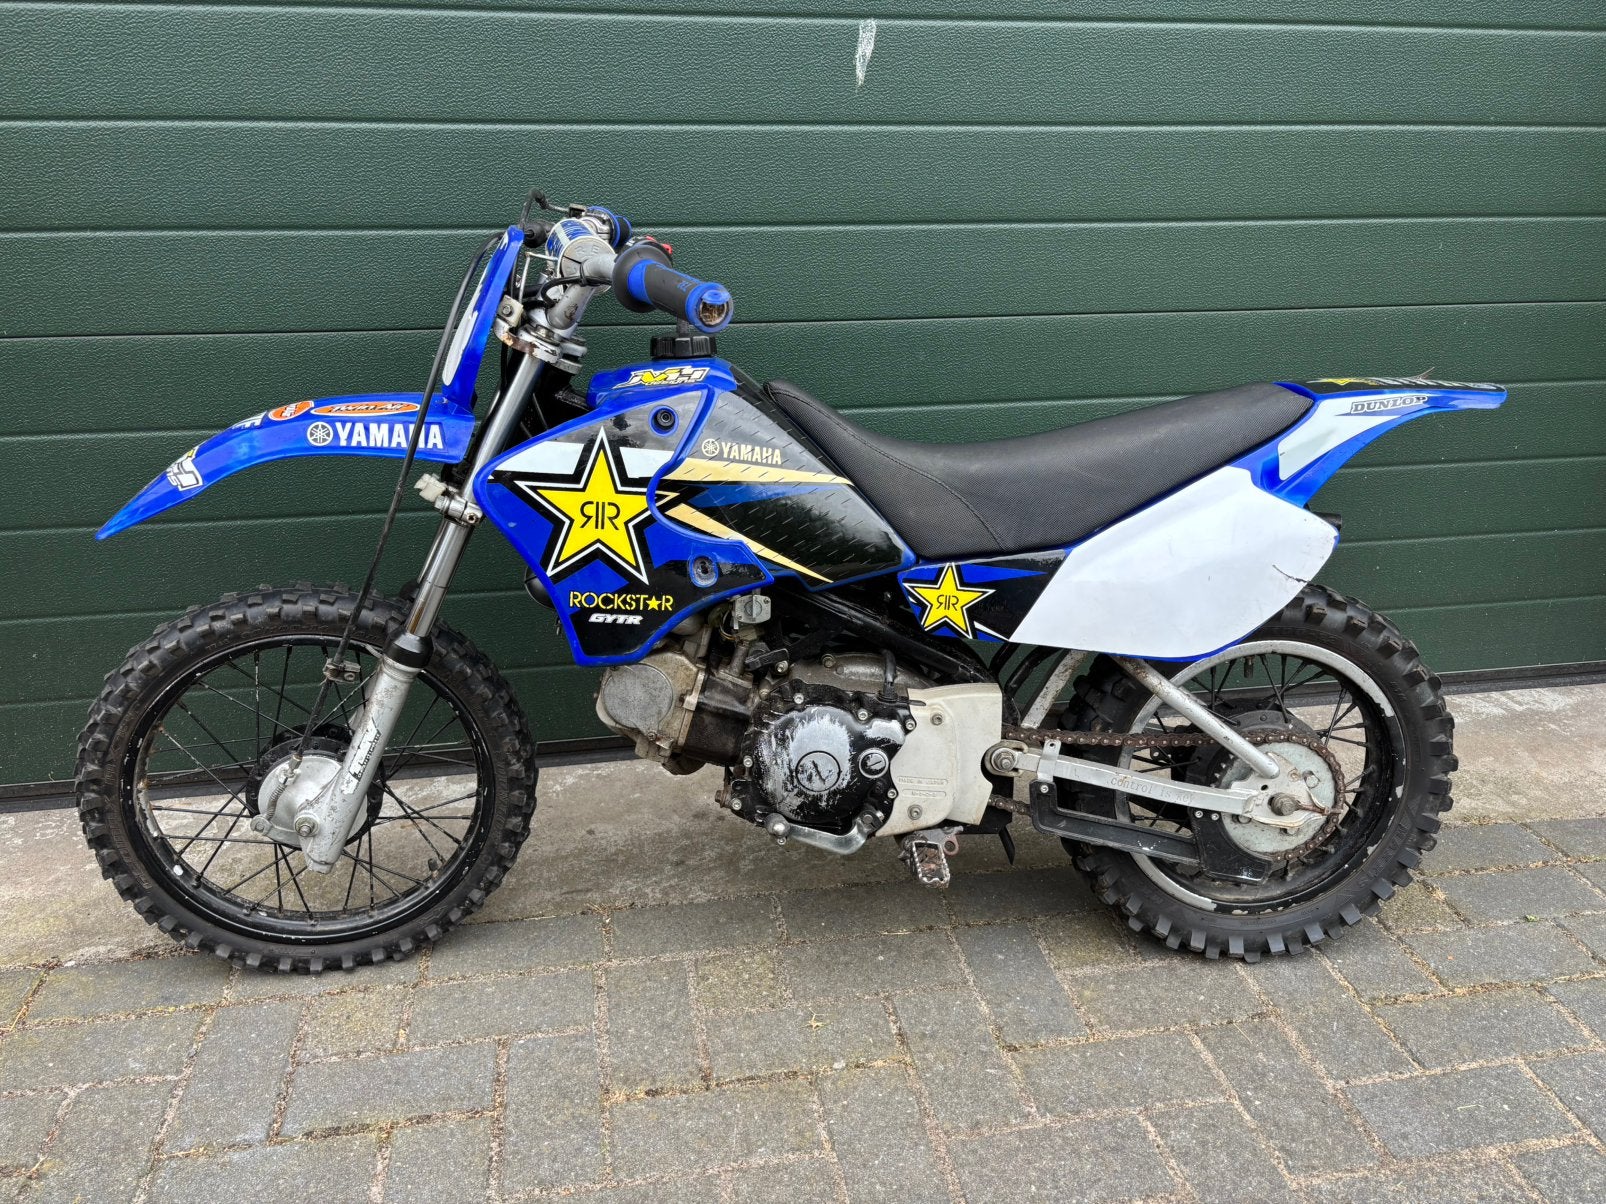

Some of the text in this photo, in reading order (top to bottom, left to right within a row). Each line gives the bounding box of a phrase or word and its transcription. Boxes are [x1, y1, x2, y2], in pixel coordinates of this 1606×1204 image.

[1352, 395, 1428, 413] DUNLOP
[335, 421, 444, 449] YAMAHA
[721, 442, 782, 465] YAMAHA
[588, 612, 644, 625] GYTR
[1110, 777, 1153, 795] control
